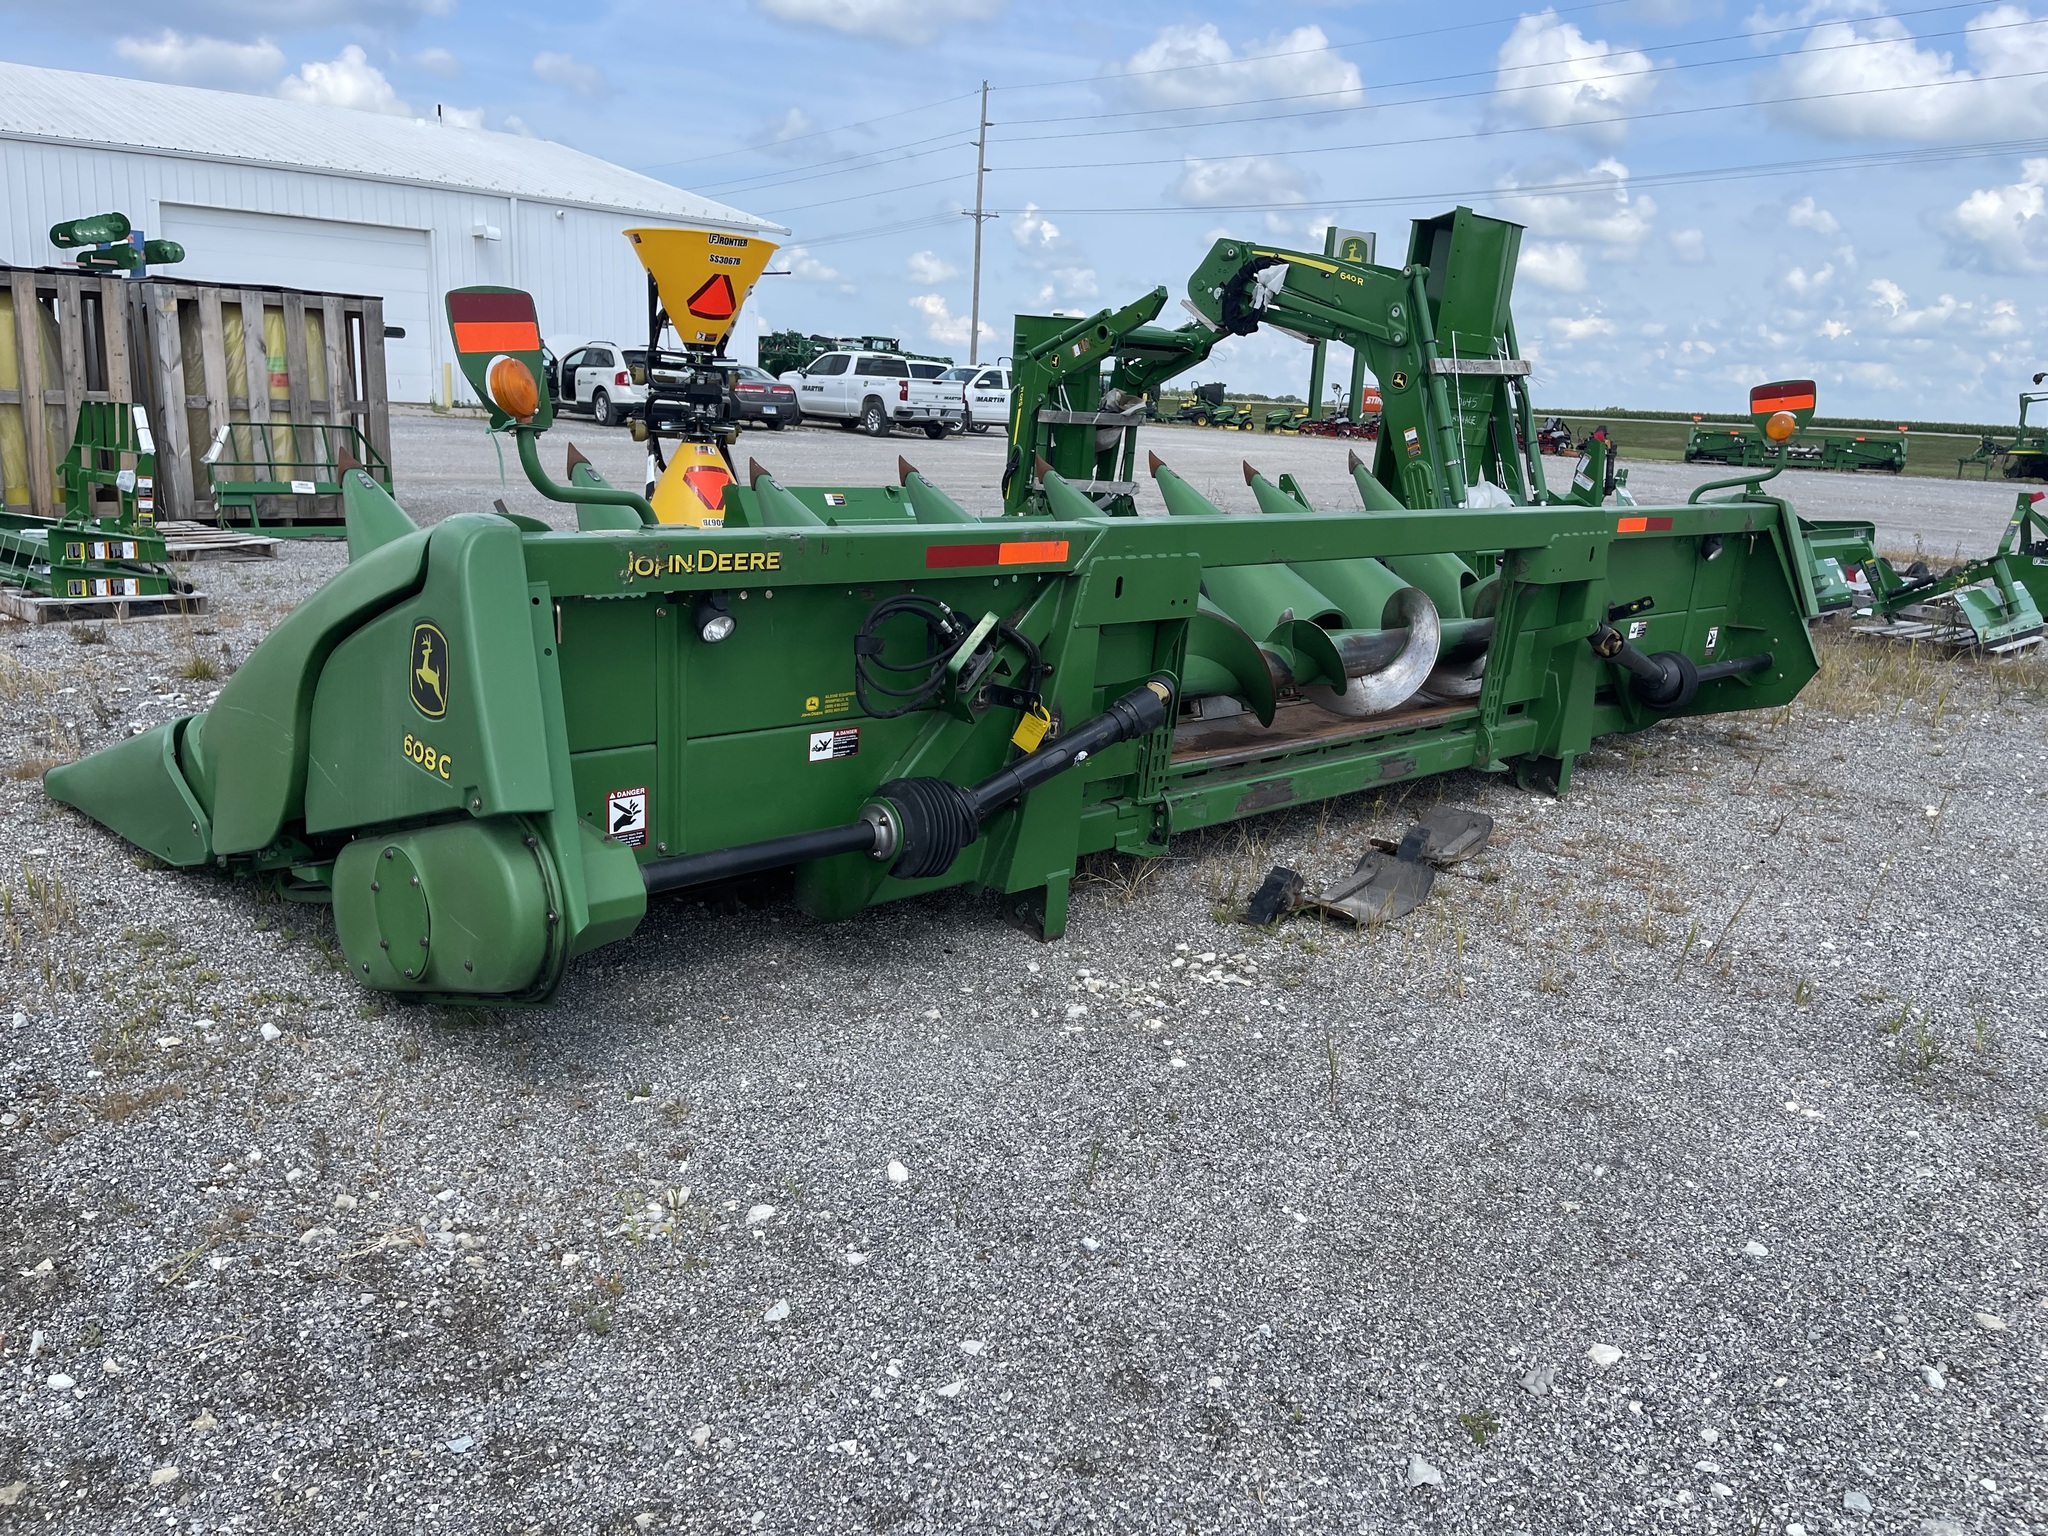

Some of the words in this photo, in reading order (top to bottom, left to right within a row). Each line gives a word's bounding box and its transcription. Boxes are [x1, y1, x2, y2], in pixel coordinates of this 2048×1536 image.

[709, 233, 748, 247] FRONTIER
[709, 254, 741, 266] SS3067B
[802, 385, 824, 393] MARTIN
[697, 550, 781, 573] DEERE
[617, 788, 645, 798] DANGER
